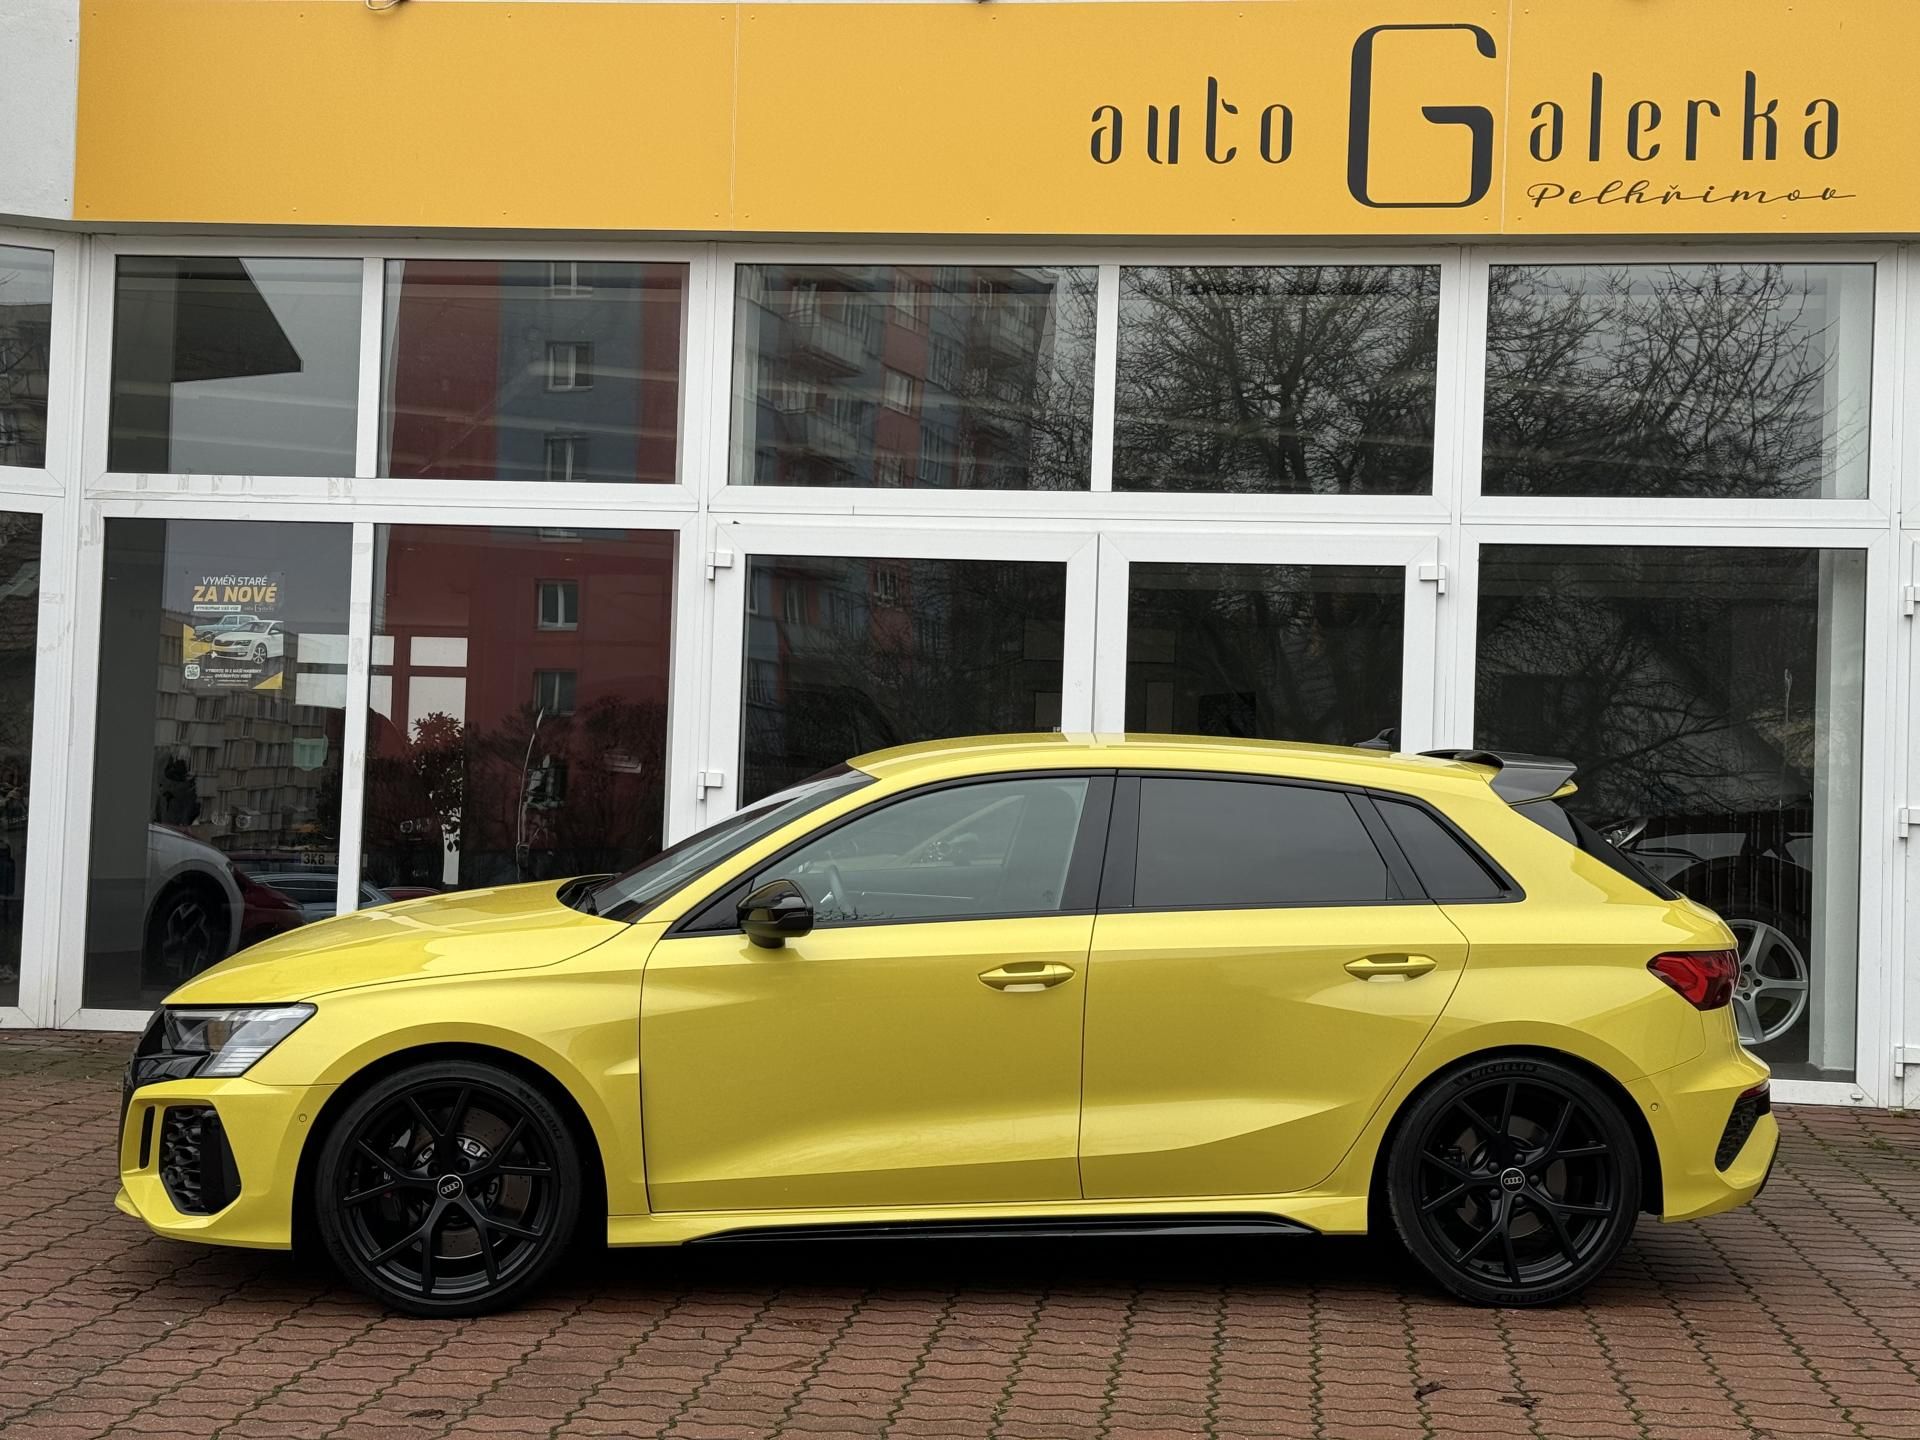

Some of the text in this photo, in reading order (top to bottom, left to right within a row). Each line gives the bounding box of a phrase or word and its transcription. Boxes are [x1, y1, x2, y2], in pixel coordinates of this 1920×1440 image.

[1090, 23, 1839, 208] auto Galerka
[1527, 179, 1856, 208] Pelhřimov
[202, 574, 268, 586] VYMĚŇ STARÉ
[192, 582, 278, 602] ZA NOVÉ
[303, 853, 325, 865] 3K8
